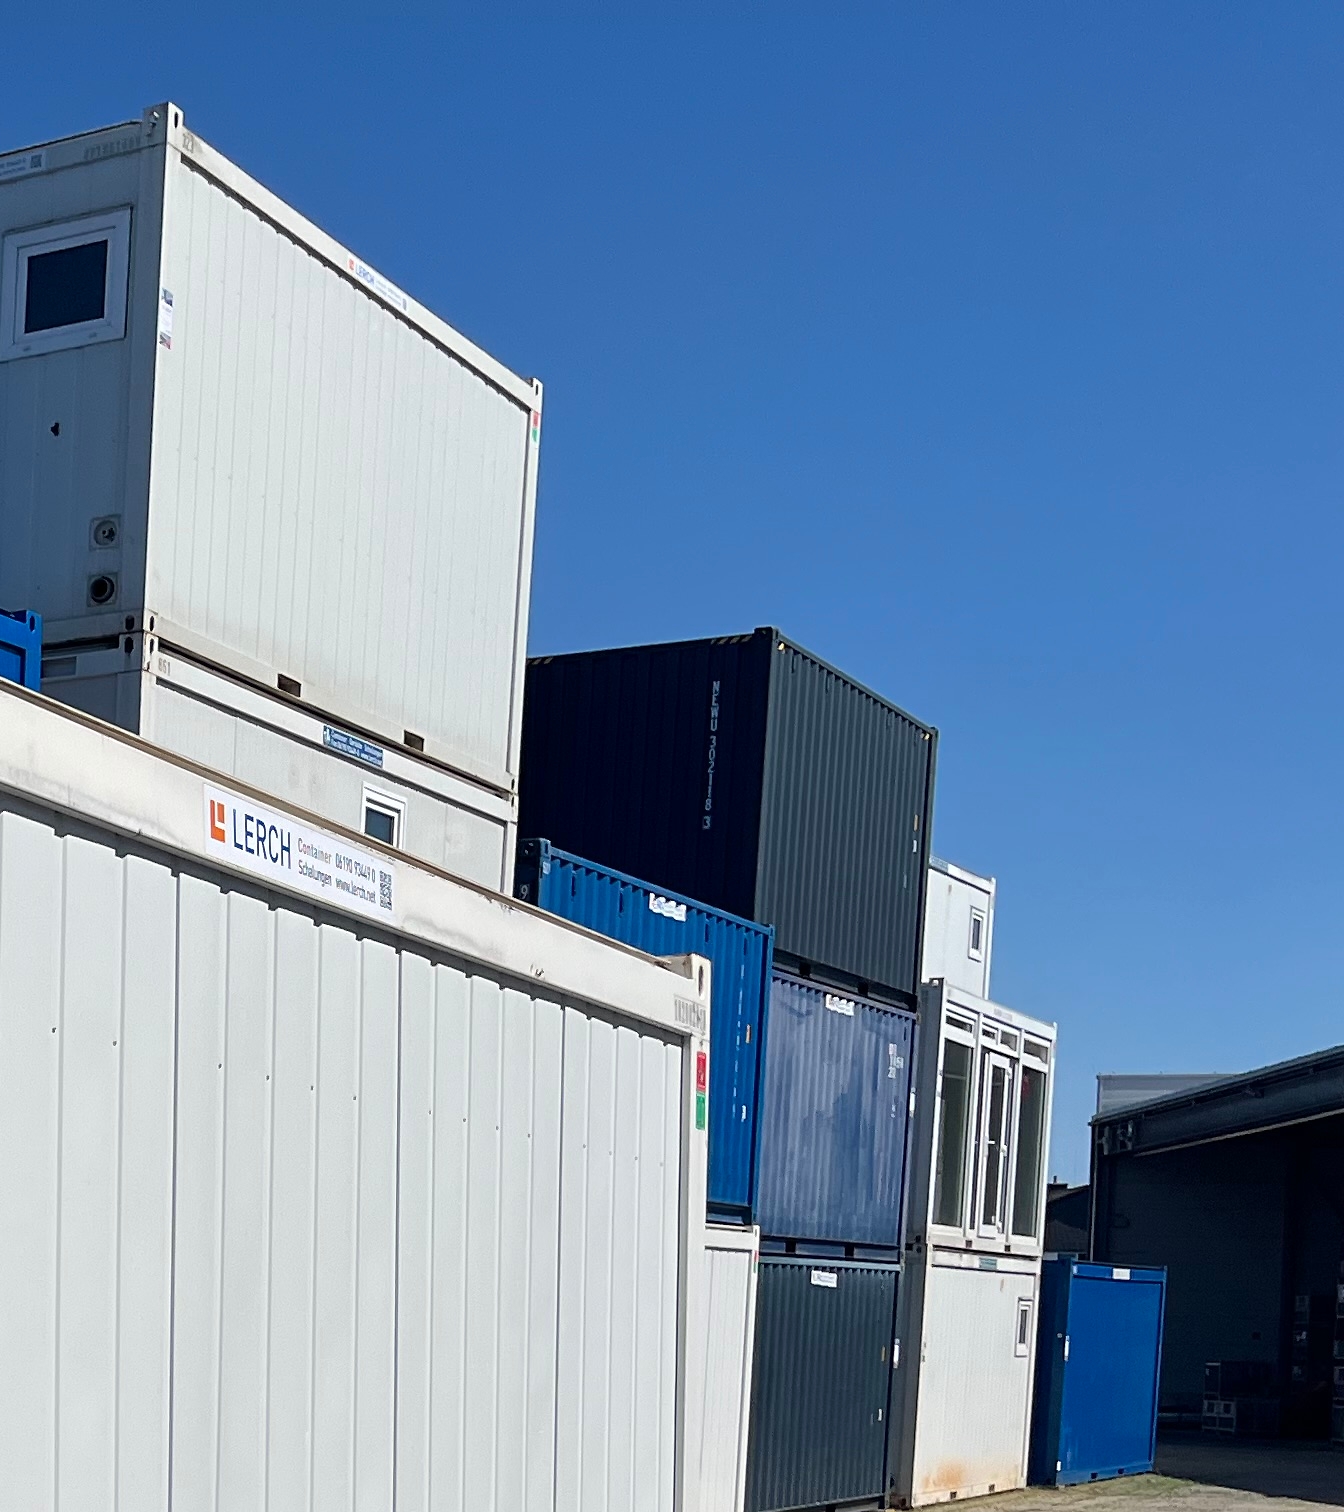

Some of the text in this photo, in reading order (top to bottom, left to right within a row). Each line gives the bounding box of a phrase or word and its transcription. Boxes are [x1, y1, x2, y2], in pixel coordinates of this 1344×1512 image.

[232, 808, 292, 870] LERCH
[297, 837, 332, 864] Container
[298, 859, 332, 888] Schalungen
